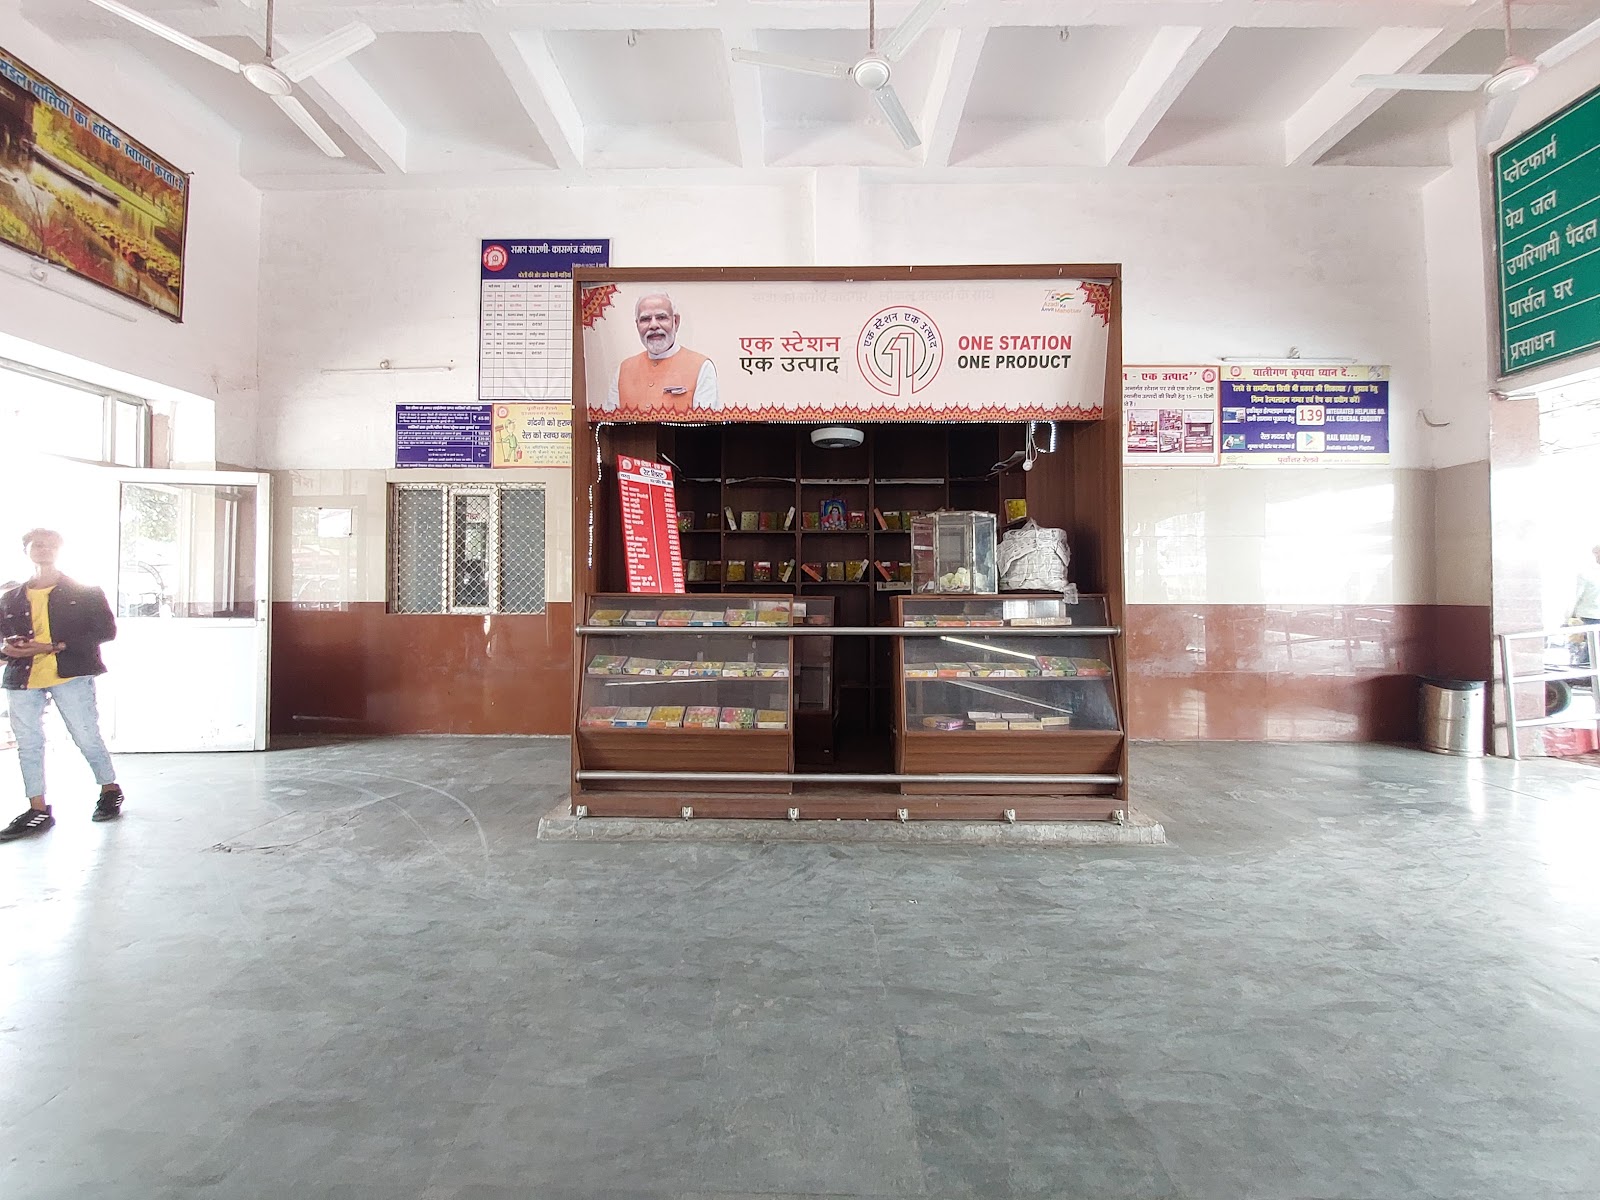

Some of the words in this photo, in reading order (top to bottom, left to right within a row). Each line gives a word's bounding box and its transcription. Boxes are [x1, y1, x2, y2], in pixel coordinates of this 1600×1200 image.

[74, 109, 88, 129] का
[92, 121, 121, 149] हार्दिक
[125, 143, 152, 171] स्वागत
[154, 164, 176, 186] करता
[1503, 134, 1556, 183] प्लेटफार्म
[1505, 207, 1524, 229] पेय
[1530, 189, 1556, 215] जल
[511, 245, 527, 254] समय
[552, 243, 578, 254] कासगंज
[579, 243, 602, 254] जंक्शन
[1506, 230, 1560, 275] उपरिगामी
[1566, 219, 1597, 247] पैदल
[1509, 286, 1545, 318] पार्सल
[1552, 278, 1573, 300] घर
[864, 330, 875, 347] एक
[873, 313, 898, 330] स्टेशन
[904, 313, 920, 325] एक
[920, 322, 937, 349] उत्पाद
[739, 337, 774, 355] एक
[780, 331, 841, 352] स्टेशन
[958, 335, 994, 350] ONE
[999, 335, 1072, 350] STATION
[1510, 330, 1555, 364] प्रसाधन
[739, 357, 774, 375] एक
[780, 357, 840, 374] उत्पाद
[957, 355, 990, 369] ONE
[996, 355, 1071, 369] PRODUCT
[1141, 373, 1158, 381] एक
[1252, 367, 1288, 377] यात्रीगण
[1291, 369, 1315, 379] कृपया
[1318, 369, 1338, 377] ध्यान
[527, 417, 545, 426] गंदगी
[547, 418, 555, 426] को
[1299, 409, 1323, 422] 139
[522, 430, 531, 439] रेल
[533, 430, 541, 439] को
[543, 431, 559, 439] स्वच्छ
[1360, 434, 1371, 442] App
